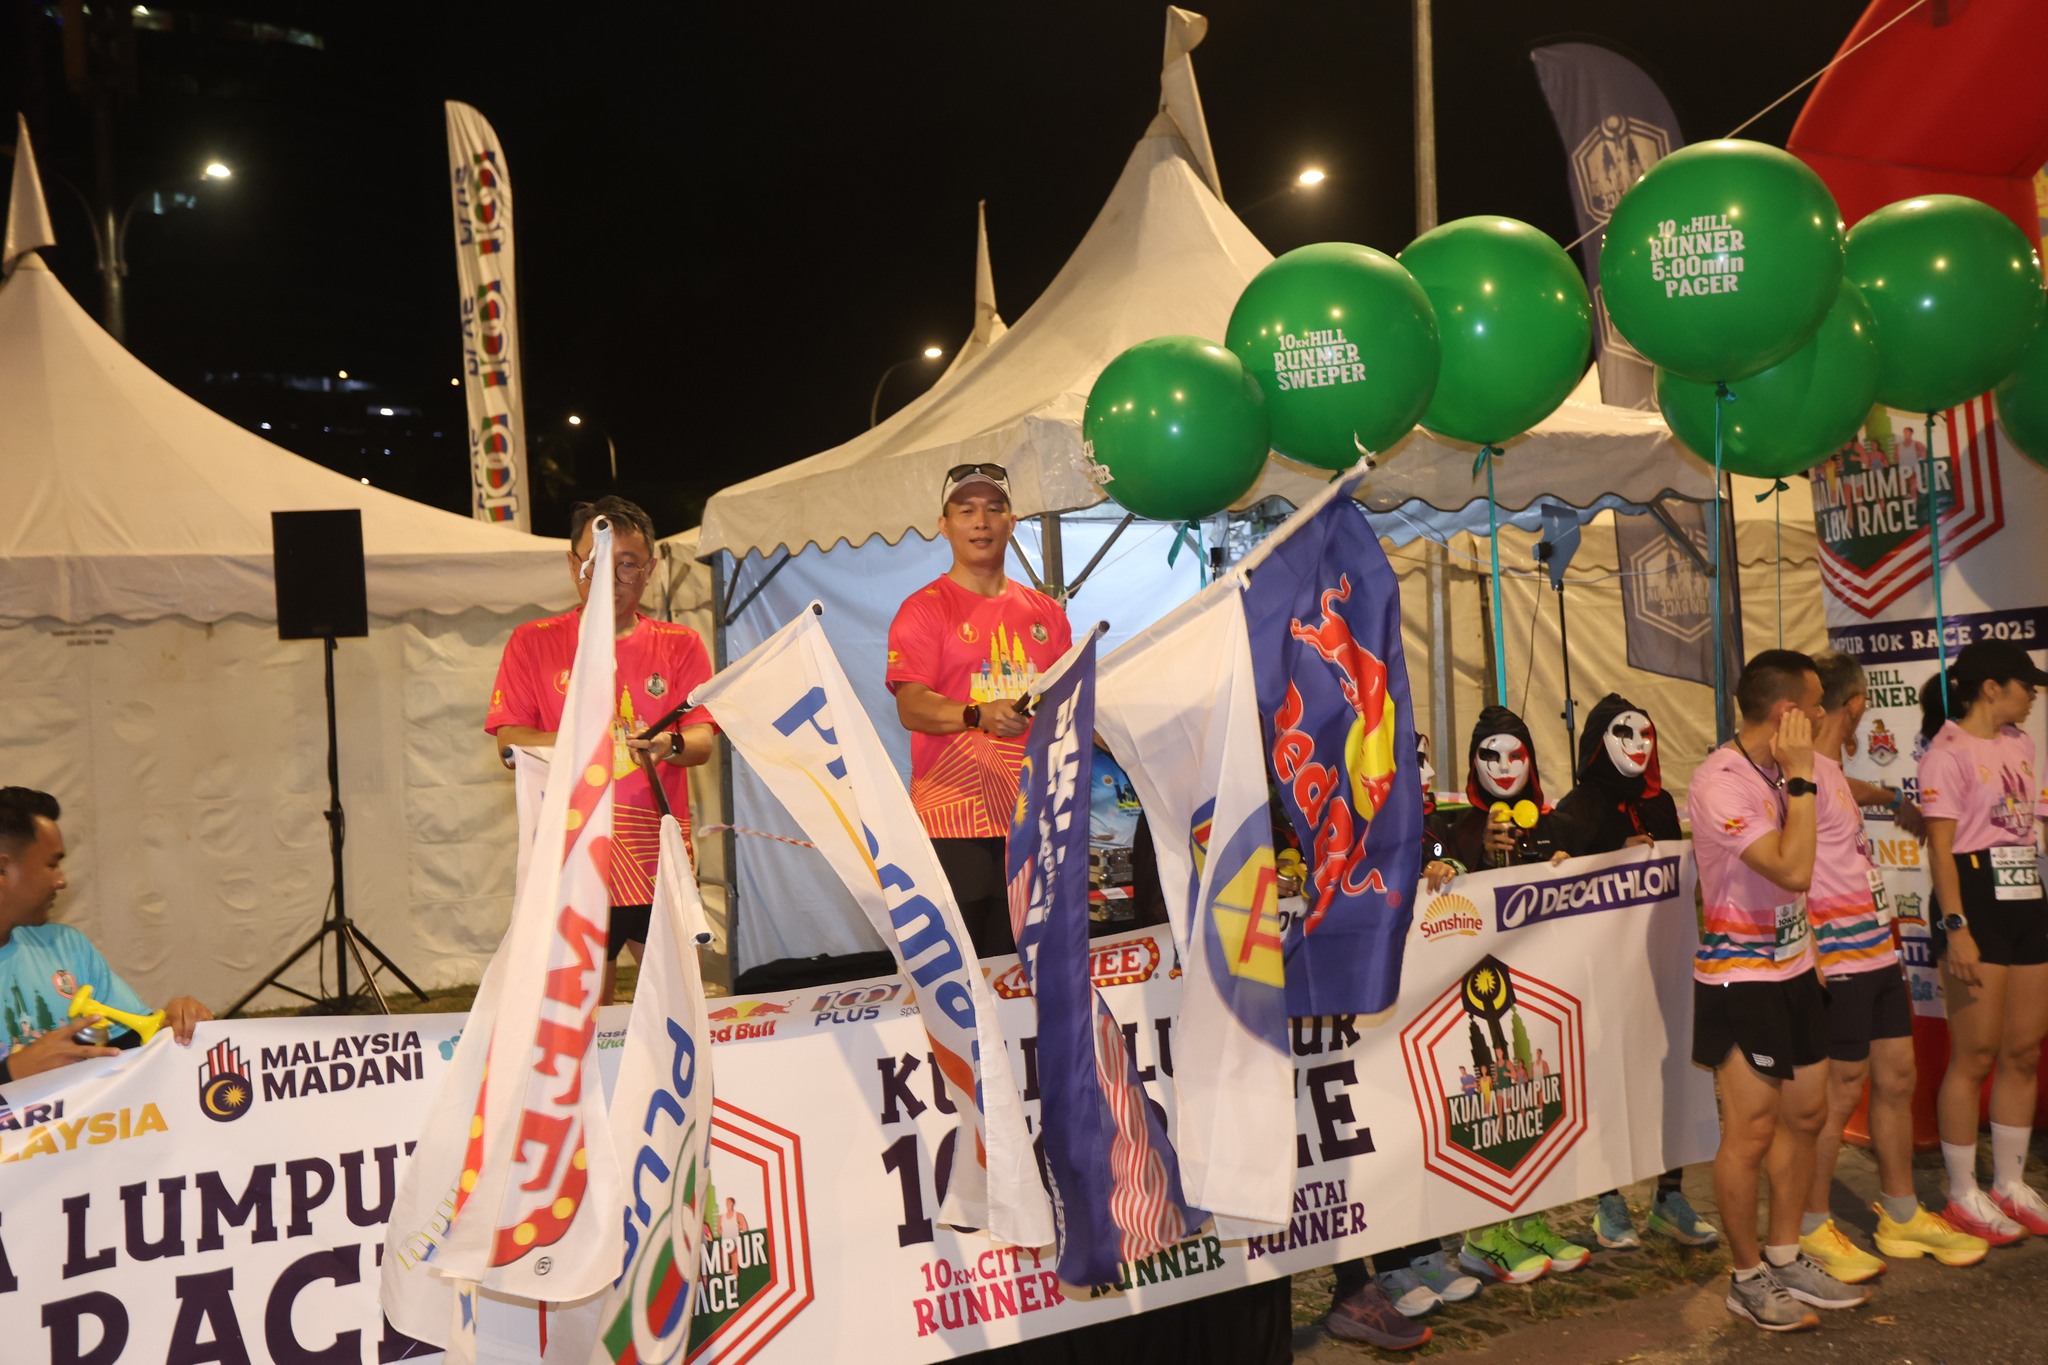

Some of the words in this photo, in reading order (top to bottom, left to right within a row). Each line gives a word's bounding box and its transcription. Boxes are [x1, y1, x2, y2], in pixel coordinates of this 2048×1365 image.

[1650, 229, 1745, 261] RUNNER
[1665, 274, 1738, 298] PACER
[1273, 343, 1360, 372] RUNNER
[1277, 363, 1366, 391] SWEEPER
[1857, 500, 1919, 538] RACE
[1869, 634, 1904, 652] 10K
[1911, 625, 1973, 650] RACE
[1979, 619, 2036, 641] 2025
[1868, 670, 1904, 686] HILL
[1540, 864, 1676, 916] DECATHLON
[1420, 913, 1484, 938] Sunshine
[735, 1019, 777, 1041] Bull
[815, 1004, 880, 1026] PLUS
[261, 1030, 422, 1071] MALAYSIA
[262, 1053, 424, 1102] MADANI
[1449, 1090, 1499, 1126] KUALA
[1503, 1076, 1561, 1114] LUMPUR
[1472, 1118, 1502, 1151] 10K
[1506, 1108, 1544, 1142] RACE
[62, 1139, 418, 1280] LUMPU
[1292, 1179, 1348, 1213] NTAI
[701, 1232, 768, 1276] MPUR
[694, 1274, 740, 1317] ACE
[912, 1270, 1065, 1337] RUNNER
